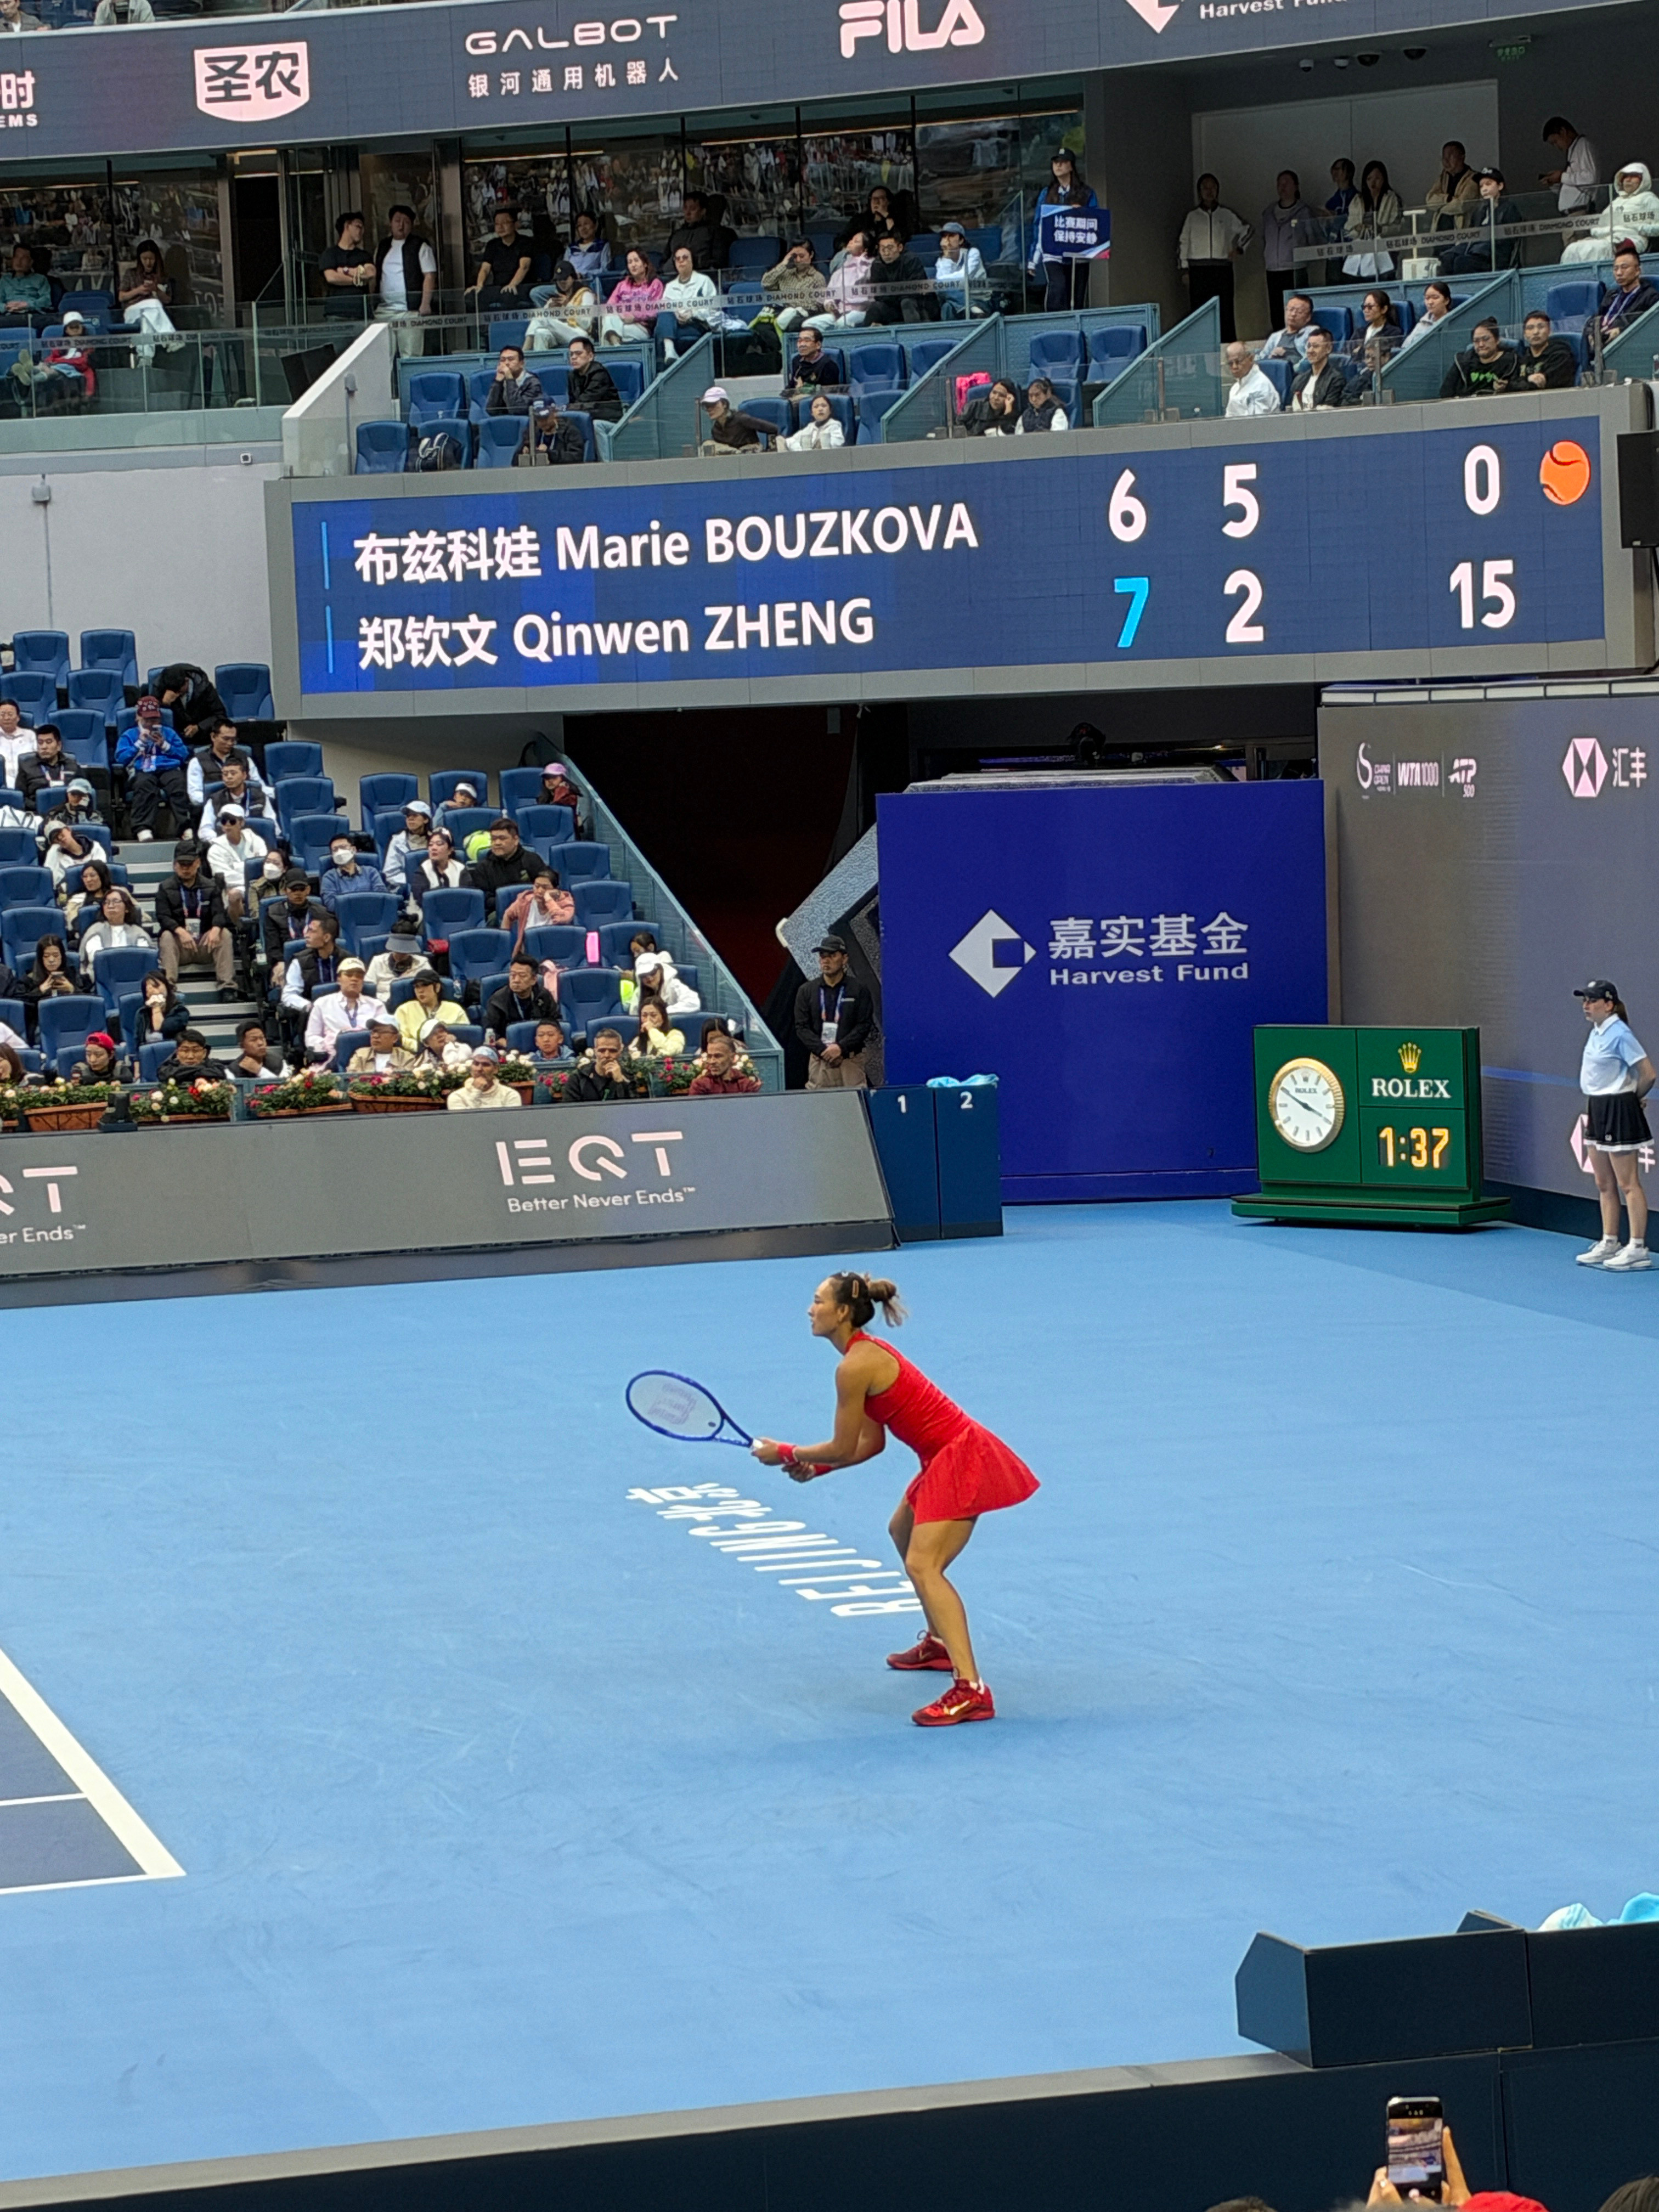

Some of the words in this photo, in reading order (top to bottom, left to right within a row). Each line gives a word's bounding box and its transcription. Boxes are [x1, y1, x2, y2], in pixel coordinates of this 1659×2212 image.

[1200, 0, 1284, 19] Harvest
[465, 15, 678, 55] GALBOT
[839, 0, 985, 59] FILA
[1, 71, 35, 110] 时
[204, 50, 301, 104] 圣农
[468, 57, 679, 98] 银河通用机器人
[766, 292, 805, 301] DIAMOND
[808, 290, 836, 298] COURT
[932, 280, 960, 289] COURT
[522, 310, 561, 319] DIAMOND
[563, 308, 591, 317] COURT
[645, 302, 684, 311] DIAMOND
[686, 299, 714, 307] COURT
[353, 525, 542, 585] 布兹科娃
[556, 520, 690, 571] Marie
[706, 503, 979, 563] BOUZKOVA
[1109, 469, 1147, 542] 6
[1222, 463, 1260, 538] 5
[1464, 445, 1500, 515] 0
[358, 613, 498, 670] 郑钦文
[513, 611, 689, 663] Qinwen
[704, 597, 873, 650] ZHENG
[1114, 577, 1150, 648] 7
[1223, 569, 1264, 643] 2
[1449, 559, 1516, 629] 15
[1448, 758, 1477, 783] ATP
[1612, 747, 1647, 788] 汇丰
[1048, 912, 1248, 960] 嘉实基金
[1051, 966, 1164, 985] Harvest
[1177, 962, 1248, 981] Fund
[898, 1095, 906, 1113] 1
[960, 1091, 973, 1109] 2
[1372, 1078, 1451, 1098] ROLEX
[495, 1131, 683, 1186] EQT
[1379, 1127, 1449, 1169] 1:37
[507, 1198, 569, 1212] Better
[573, 1194, 632, 1208] Never
[625, 1482, 772, 1521] 北京
[687, 1520, 924, 1617] BEIJING
